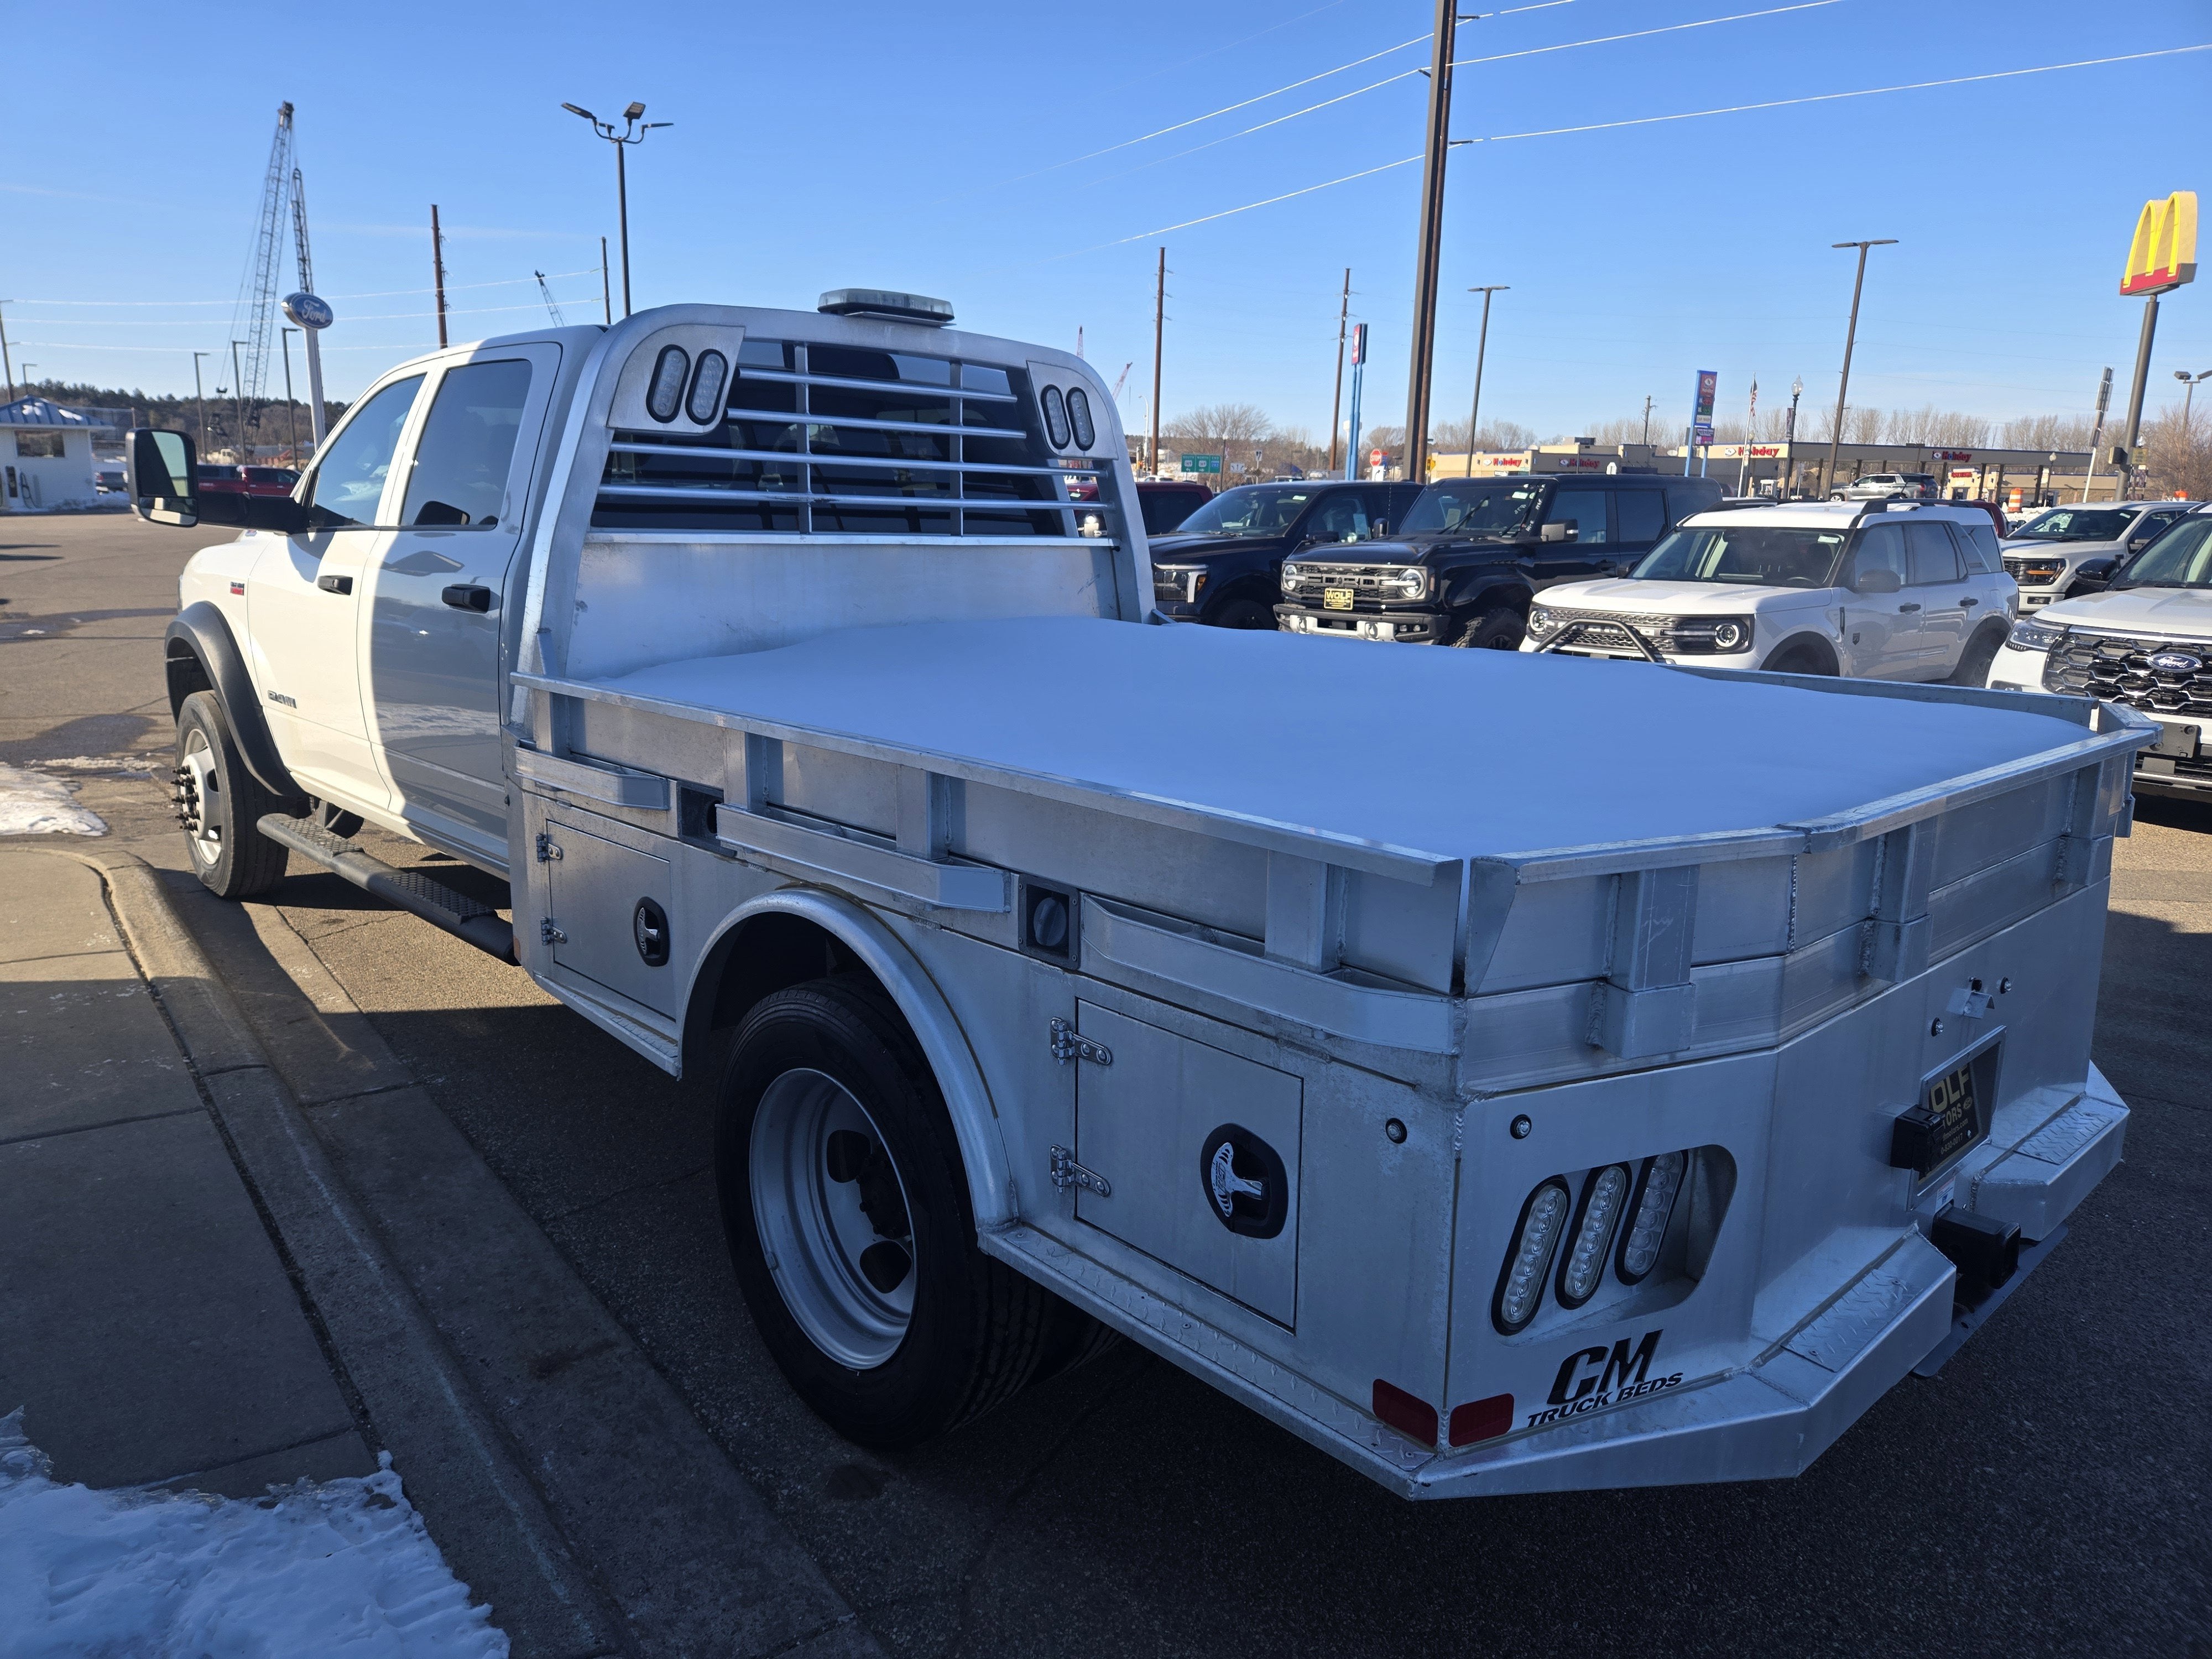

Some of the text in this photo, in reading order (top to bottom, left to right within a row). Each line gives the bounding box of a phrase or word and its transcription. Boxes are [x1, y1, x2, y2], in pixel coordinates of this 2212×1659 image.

[301, 299, 326, 322] Ford
[1738, 446, 1780, 458] Hliday
[1942, 451, 1972, 462] Holiday
[1493, 457, 1522, 467] Holiday
[1326, 591, 1352, 599] WOLF
[2157, 656, 2189, 668] Ford
[1931, 1064, 1970, 1113] OLF
[1547, 1329, 1663, 1405] CM
[1527, 1372, 1683, 1428] TRUCK BEDS
